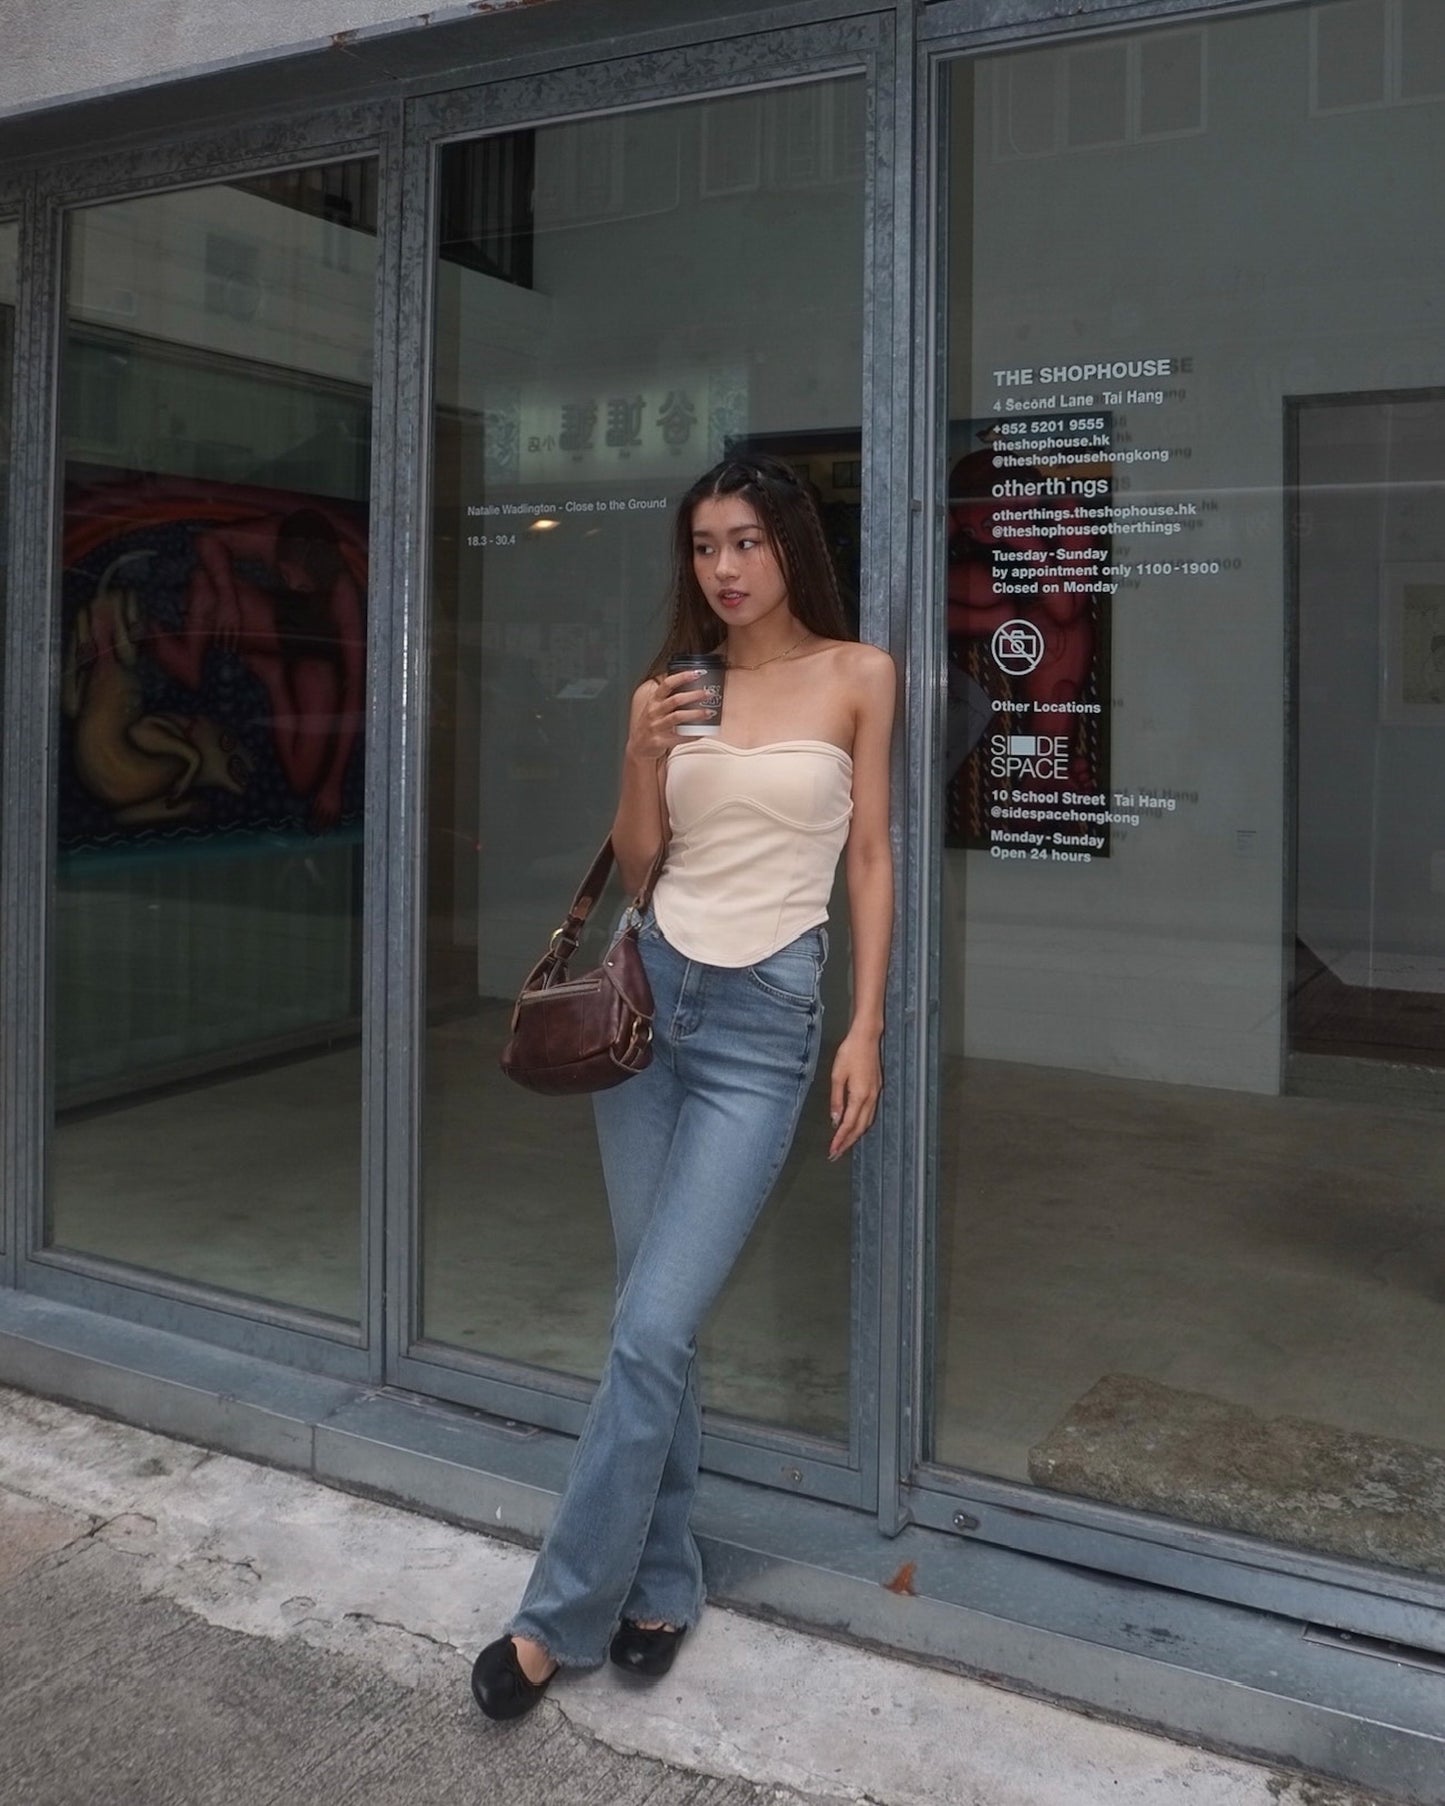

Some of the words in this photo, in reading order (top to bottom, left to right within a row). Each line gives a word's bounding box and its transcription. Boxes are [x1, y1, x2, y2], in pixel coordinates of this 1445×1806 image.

[993, 370, 1033, 386] THE
[1039, 360, 1172, 384] SHOPHOUSE
[993, 401, 1001, 412] 4
[1005, 397, 1056, 411] Second
[1060, 394, 1094, 408] Lane
[1102, 391, 1122, 405] Tai
[1127, 390, 1163, 404] Hang
[993, 423, 1027, 435] +852
[1031, 421, 1064, 433] 5201
[1069, 418, 1104, 431] 9555
[992, 434, 1110, 452] theshophouse.hk
[992, 450, 1169, 468] @theshophousehongkong
[992, 477, 1109, 498] otherthngs
[467, 504, 500, 516] Natalie
[501, 503, 556, 515] Wadlington
[565, 500, 594, 513] Close
[596, 501, 606, 511] to
[609, 499, 625, 511] the
[627, 498, 667, 510] Ground
[992, 503, 1196, 522] otherthings.theshophouse.hk
[992, 521, 1181, 538] @theshophouseotherthings
[467, 536, 487, 546] 18.3
[495, 535, 516, 546] 30.4
[992, 565, 1008, 579] by
[1011, 565, 1098, 579] appointment
[1102, 564, 1131, 577] only
[992, 582, 1038, 594] Closed
[1042, 584, 1059, 593] on
[1063, 581, 1118, 595] Monday
[991, 700, 1030, 712] Other
[1033, 701, 1101, 713] Locations
[990, 757, 1069, 780] SPACE
[991, 790, 1008, 801] 10
[1011, 790, 1058, 803] School
[1062, 792, 1106, 805] Street
[1113, 794, 1134, 807] Tai
[1138, 795, 1176, 811] Hang
[991, 807, 1140, 826] @sidespacehongkong
[990, 846, 1026, 860] Open
[1030, 848, 1047, 859] 24
[1051, 850, 1091, 862] hours
